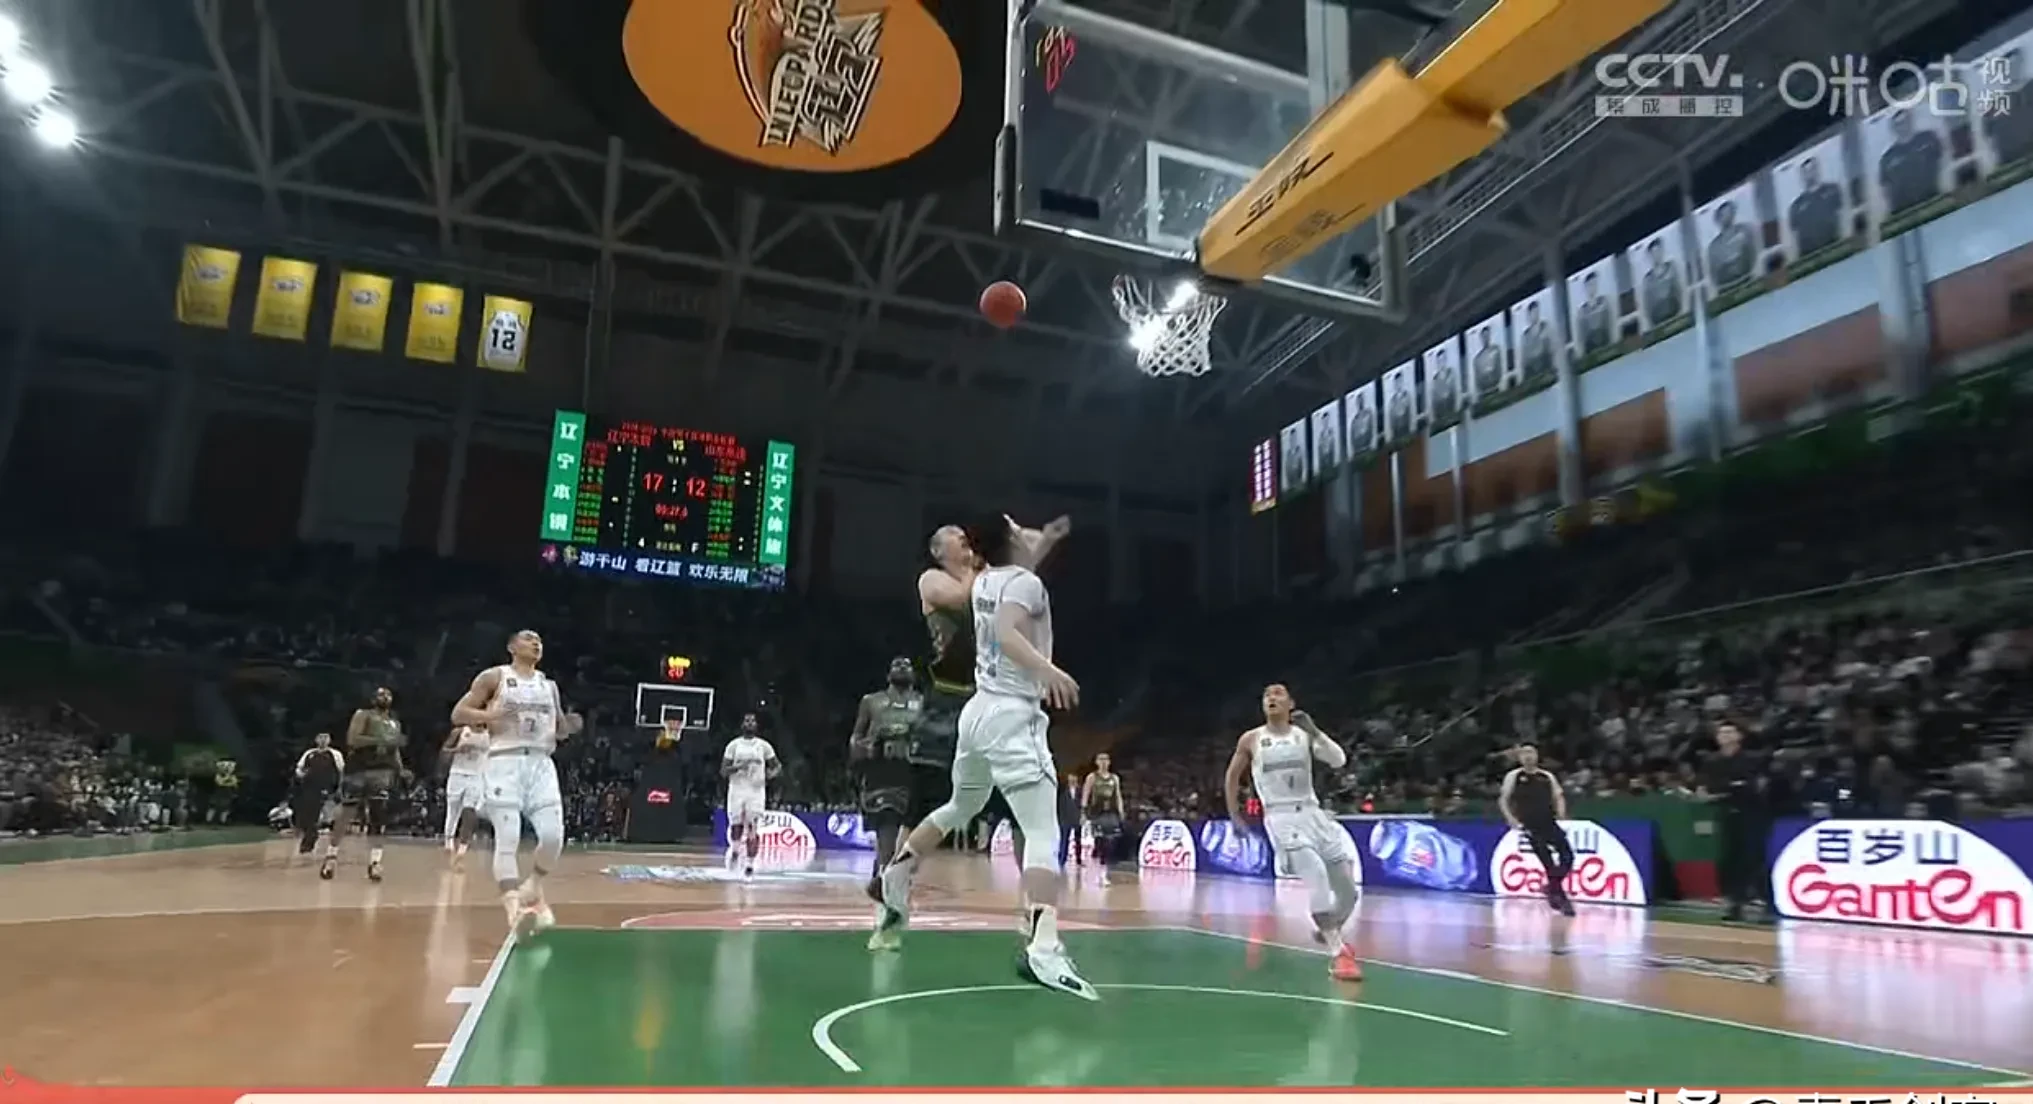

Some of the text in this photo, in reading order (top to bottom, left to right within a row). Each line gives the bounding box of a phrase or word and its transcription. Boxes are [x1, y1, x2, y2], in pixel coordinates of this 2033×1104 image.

[492, 328, 516, 351] 12
[643, 472, 665, 493] 17
[686, 477, 707, 498] 12
[1815, 828, 1958, 866] 百岁山
[1788, 864, 2023, 930] Ganten
